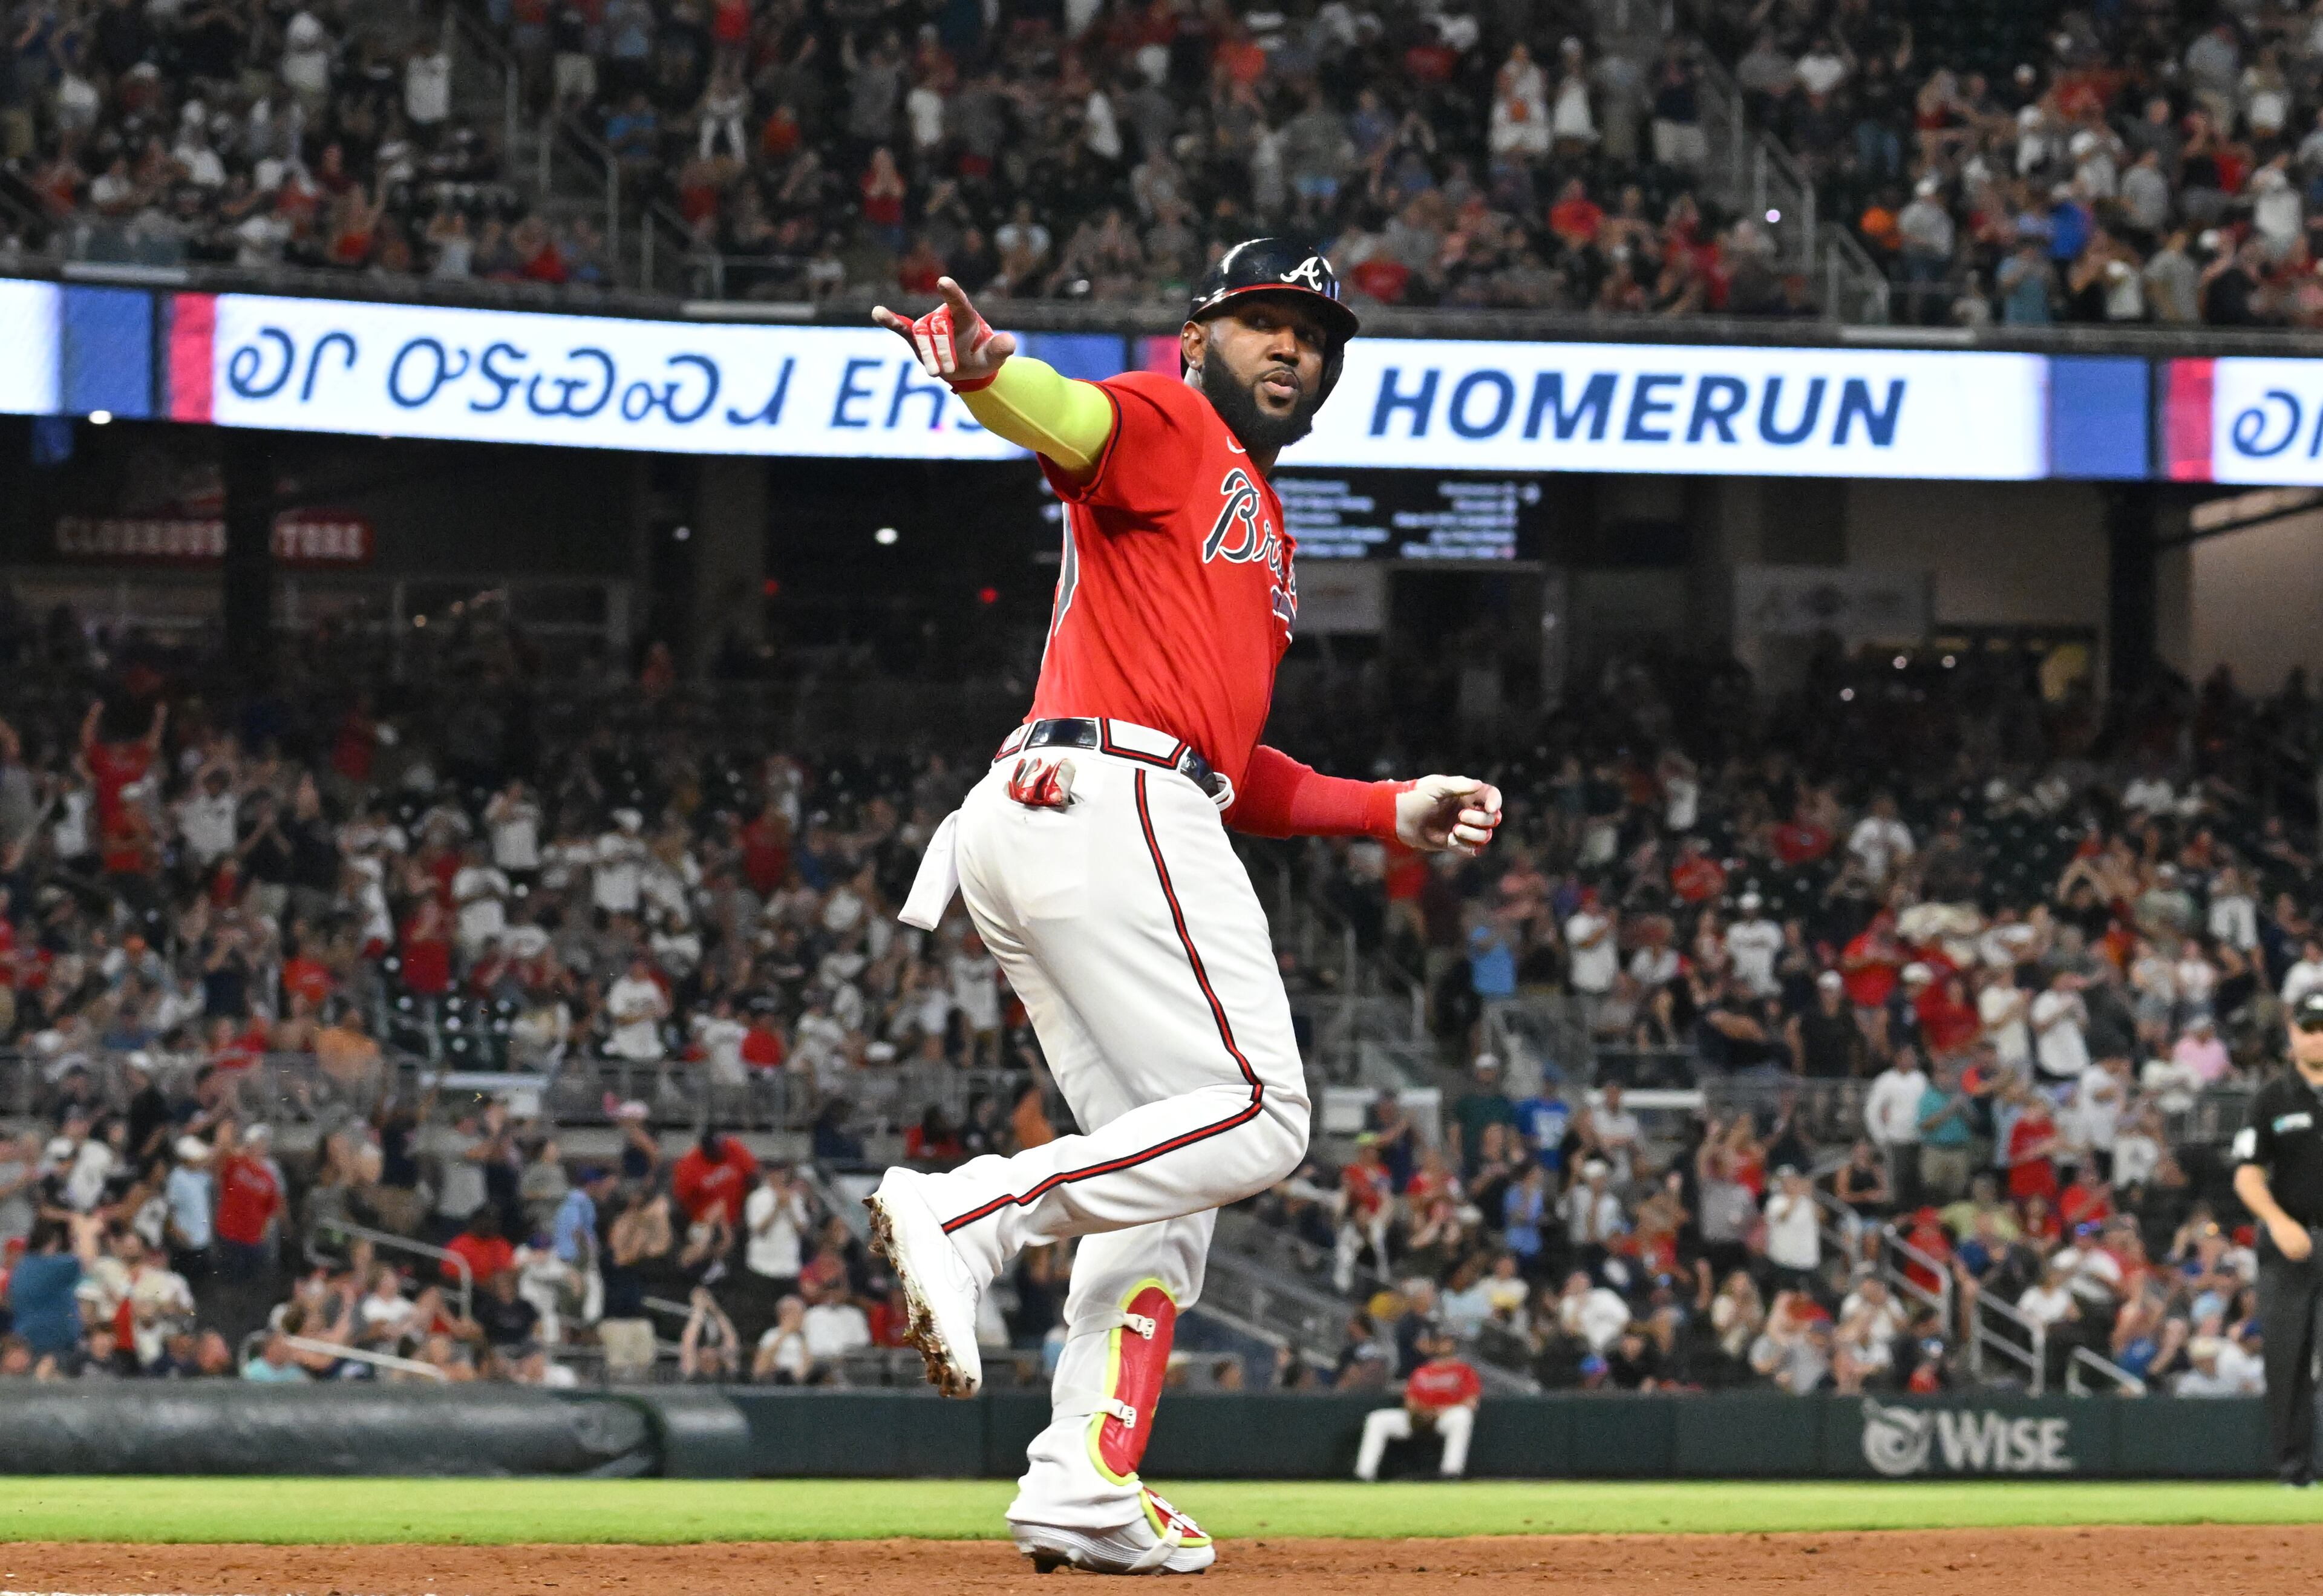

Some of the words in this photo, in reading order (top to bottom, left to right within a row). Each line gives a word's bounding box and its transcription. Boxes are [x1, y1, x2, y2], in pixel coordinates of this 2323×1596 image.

[1279, 256, 1322, 292] A
[831, 358, 987, 432] ᎬᏂ
[1370, 367, 1906, 446] HOMERUN
[2231, 390, 2323, 457] Ꭷ
[1938, 1409, 2073, 1471] WISE
